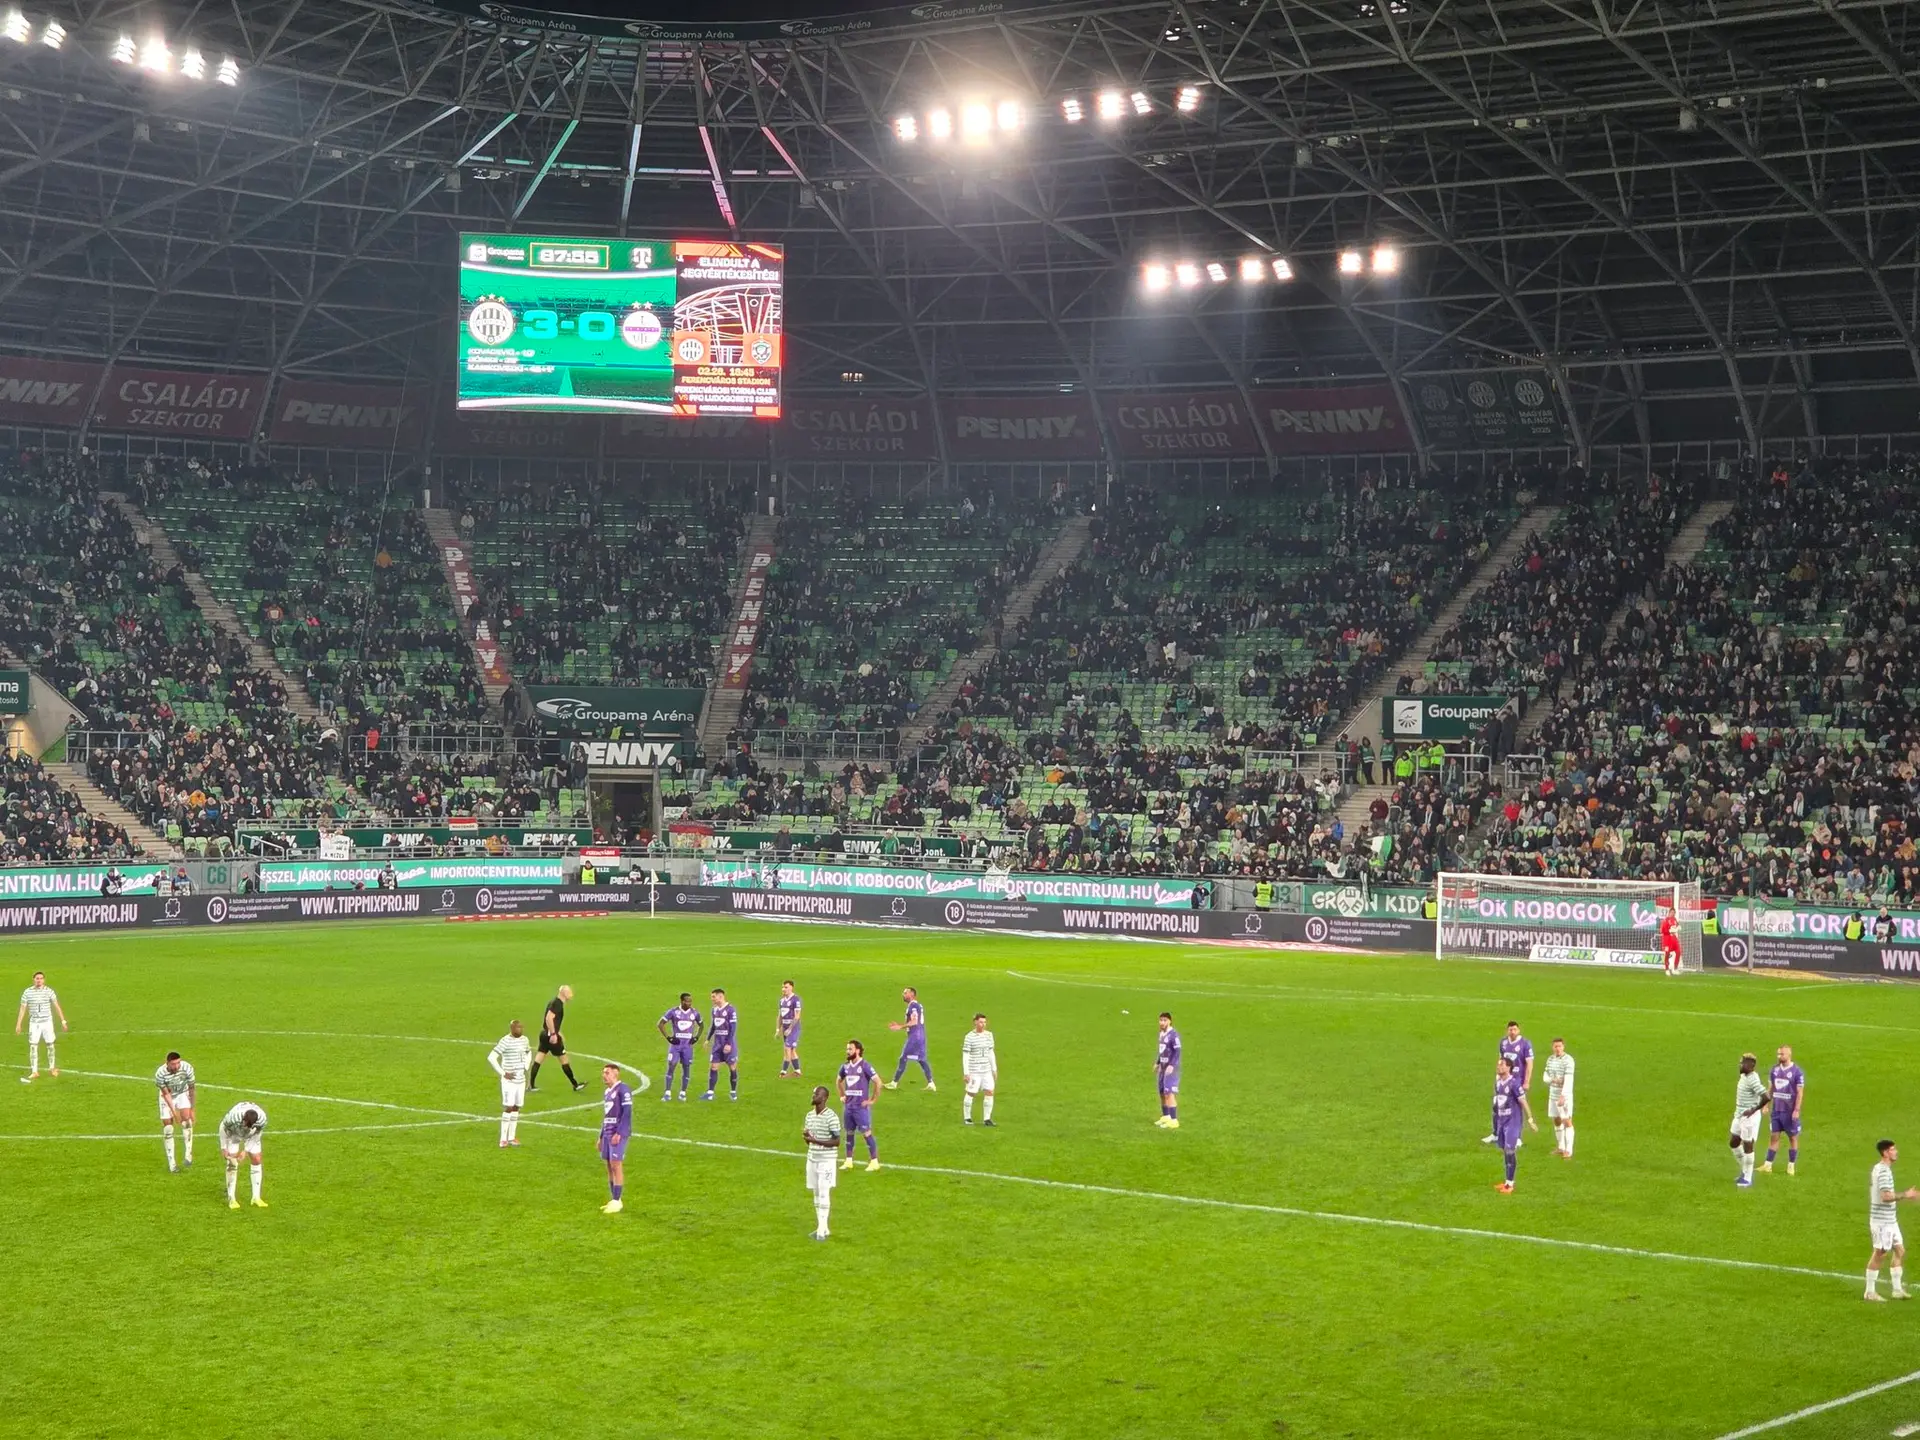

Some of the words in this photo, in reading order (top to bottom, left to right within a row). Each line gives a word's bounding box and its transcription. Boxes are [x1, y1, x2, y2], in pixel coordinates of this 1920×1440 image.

[501, 11, 546, 28] Groupama
[547, 19, 578, 32] Aréna
[933, 7, 976, 19] Groupama
[651, 29, 702, 39] Groupama
[705, 29, 736, 39] Aréna
[802, 23, 845, 36] Groupama
[699, 257, 750, 268] ELINDULT
[750, 258, 760, 268] A
[119, 379, 251, 409] CSALÁDI
[127, 408, 225, 429] SZEKTOR
[791, 404, 920, 433] CSALÁDI
[1117, 398, 1239, 430] CSALÁDI
[1518, 410, 1553, 418] MAGYAR
[1521, 417, 1556, 425] BAJNOK
[470, 428, 565, 445] SZEKTOR
[811, 436, 905, 452] SZEKTOR
[1141, 432, 1232, 449] SZEKTOR
[728, 552, 771, 674] PENNY
[574, 707, 648, 723] Groupama
[652, 708, 695, 722] Aréna
[206, 865, 227, 885] C6
[297, 867, 332, 886] JÁROK
[333, 868, 382, 882] ROBOGO
[430, 865, 563, 879] IMPORTORCENTRUM.HU
[810, 867, 852, 888] JÁROK
[856, 871, 924, 891] ROBOGOK
[926, 873, 977, 895] Vespa
[300, 894, 420, 916] WWW.TIPPMIXPRO.HU
[559, 892, 630, 904] WWW.TIPPMIXPRO.HU
[732, 891, 852, 915] WWW.TIPPMIXPRO.HU
[1063, 909, 1200, 933] WWW.TIPPMIXPRO.HU
[1513, 899, 1617, 923] ROBOGOK
